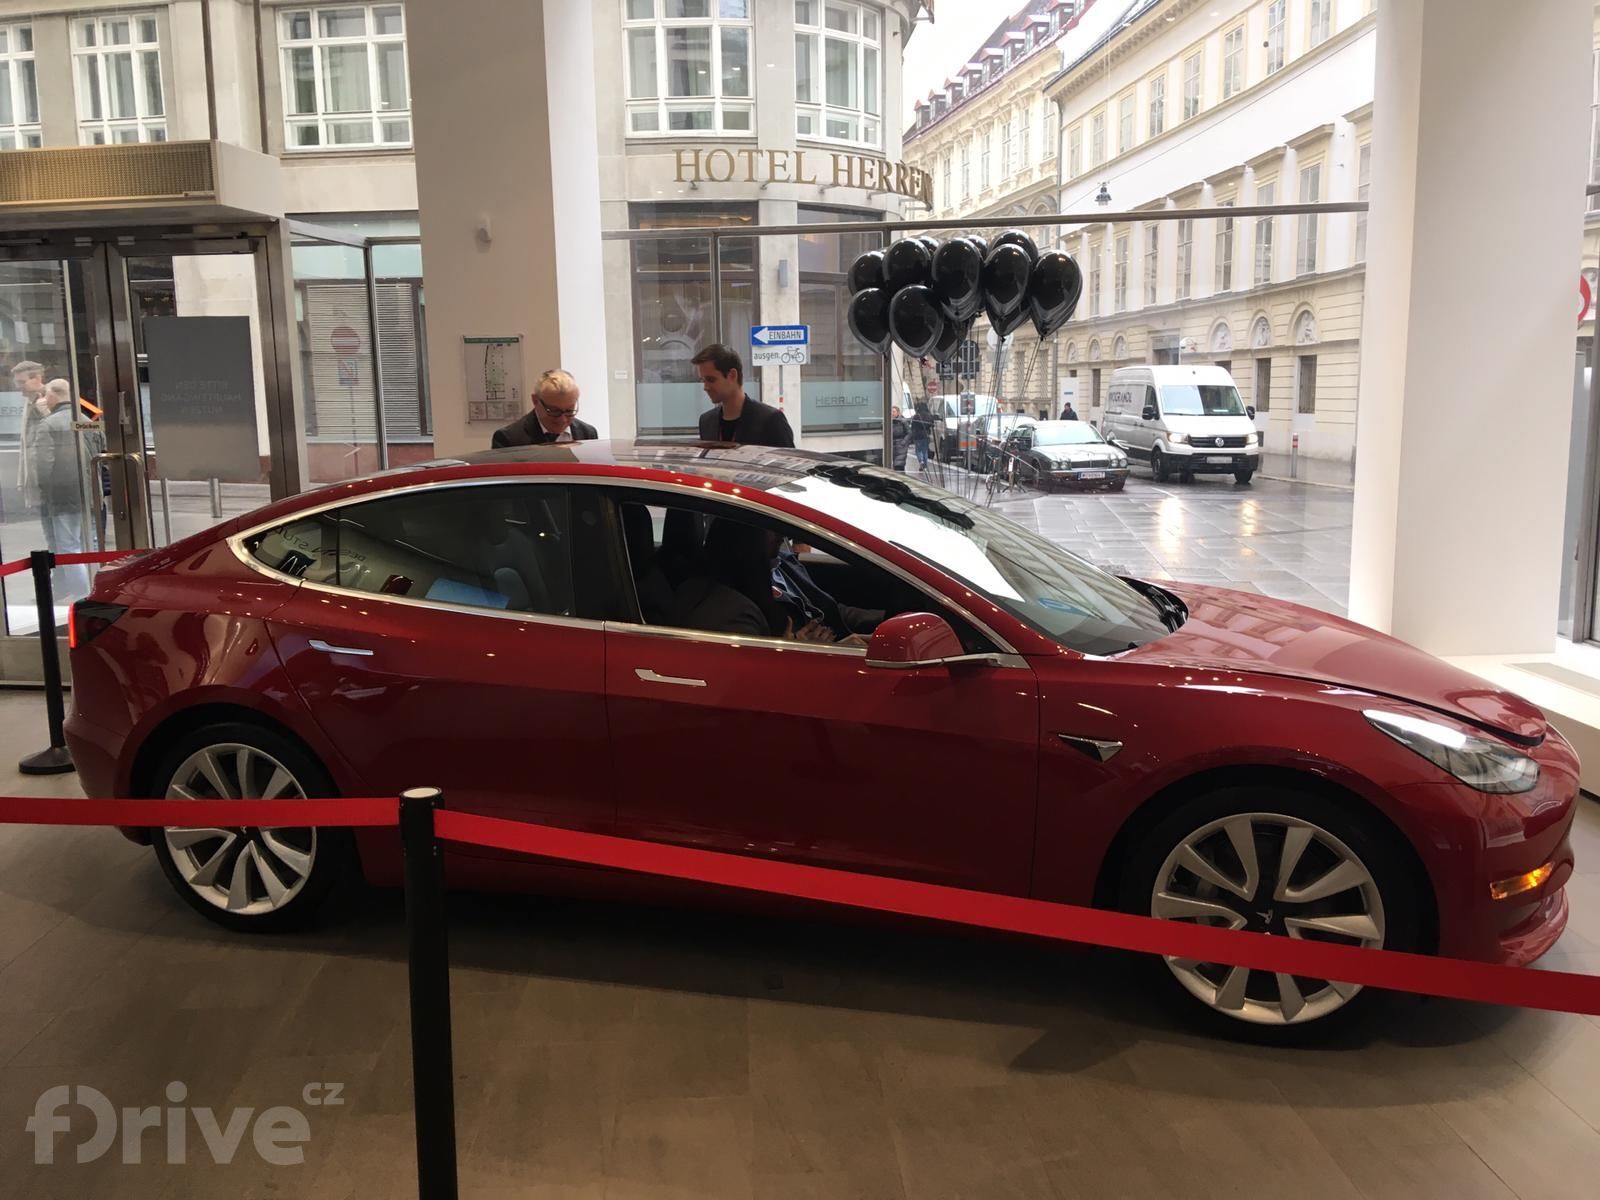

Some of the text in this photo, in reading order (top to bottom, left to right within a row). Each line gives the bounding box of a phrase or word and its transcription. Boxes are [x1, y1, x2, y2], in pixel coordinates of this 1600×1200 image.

[673, 149, 933, 211] HOTEL HERREN
[768, 330, 801, 340] EINBAHN
[815, 395, 869, 405] HERRLICH
